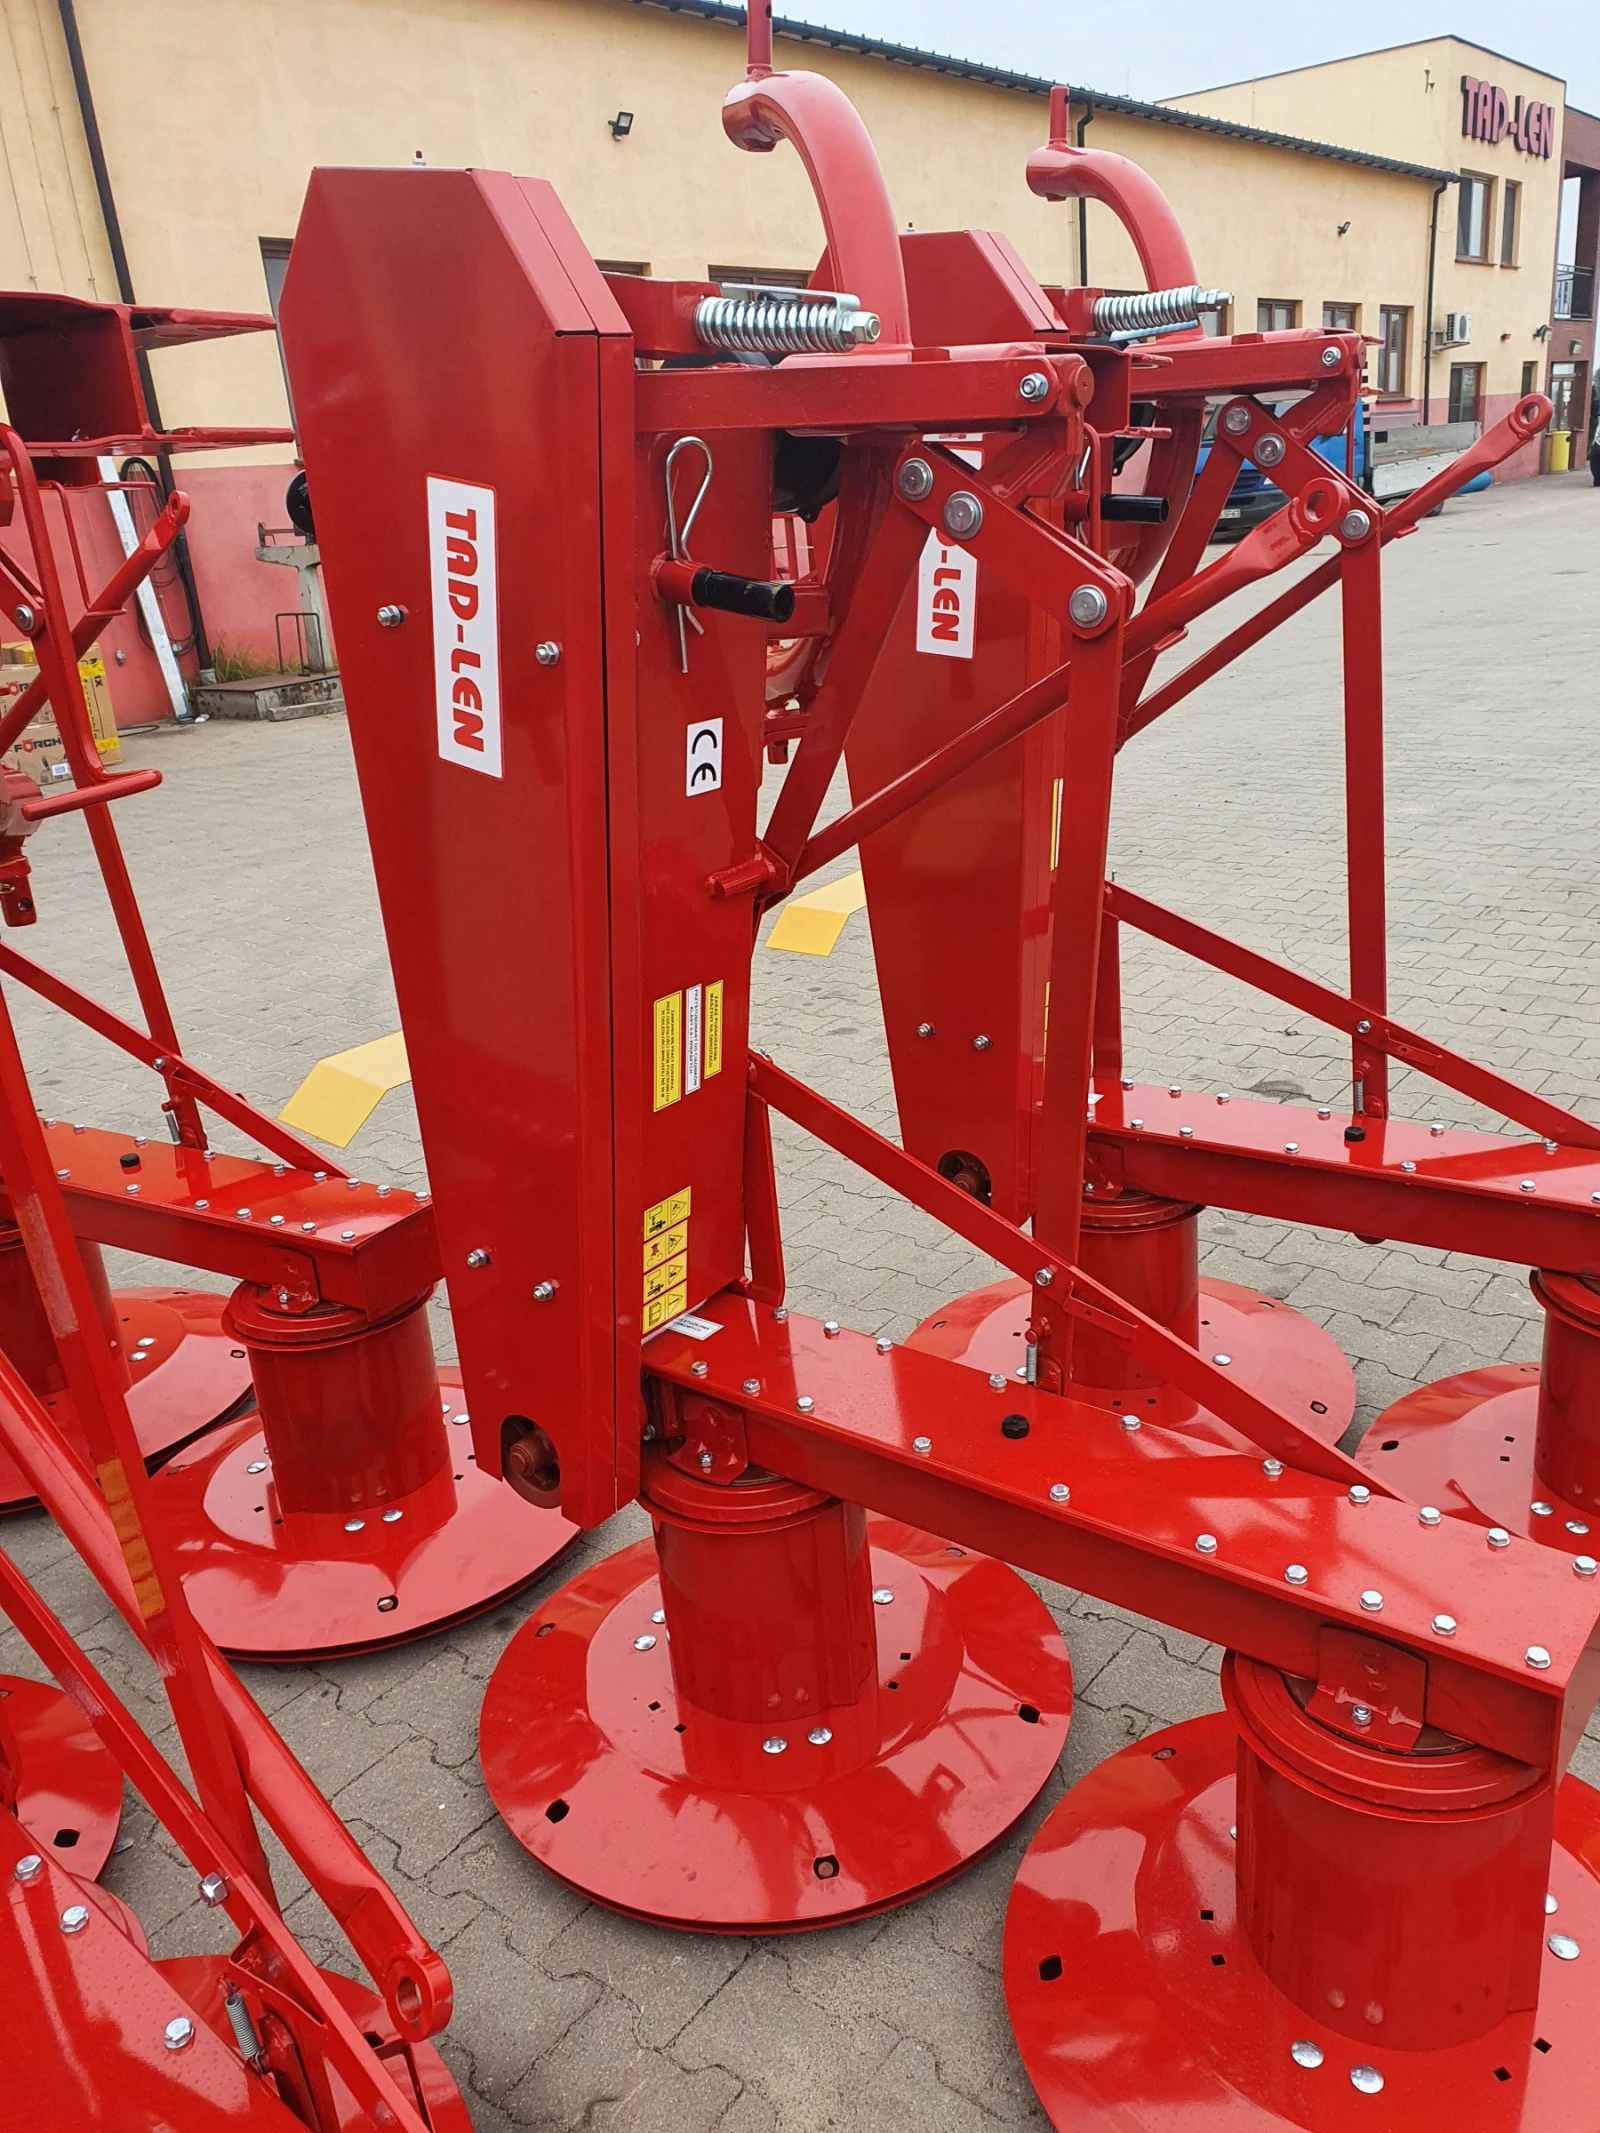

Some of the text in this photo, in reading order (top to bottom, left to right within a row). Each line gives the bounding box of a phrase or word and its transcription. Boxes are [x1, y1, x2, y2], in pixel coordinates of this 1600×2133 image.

[1461, 75, 1555, 159] TAD-LEN
[445, 508, 485, 752] TAD-LEN
[690, 729, 717, 787] CE
